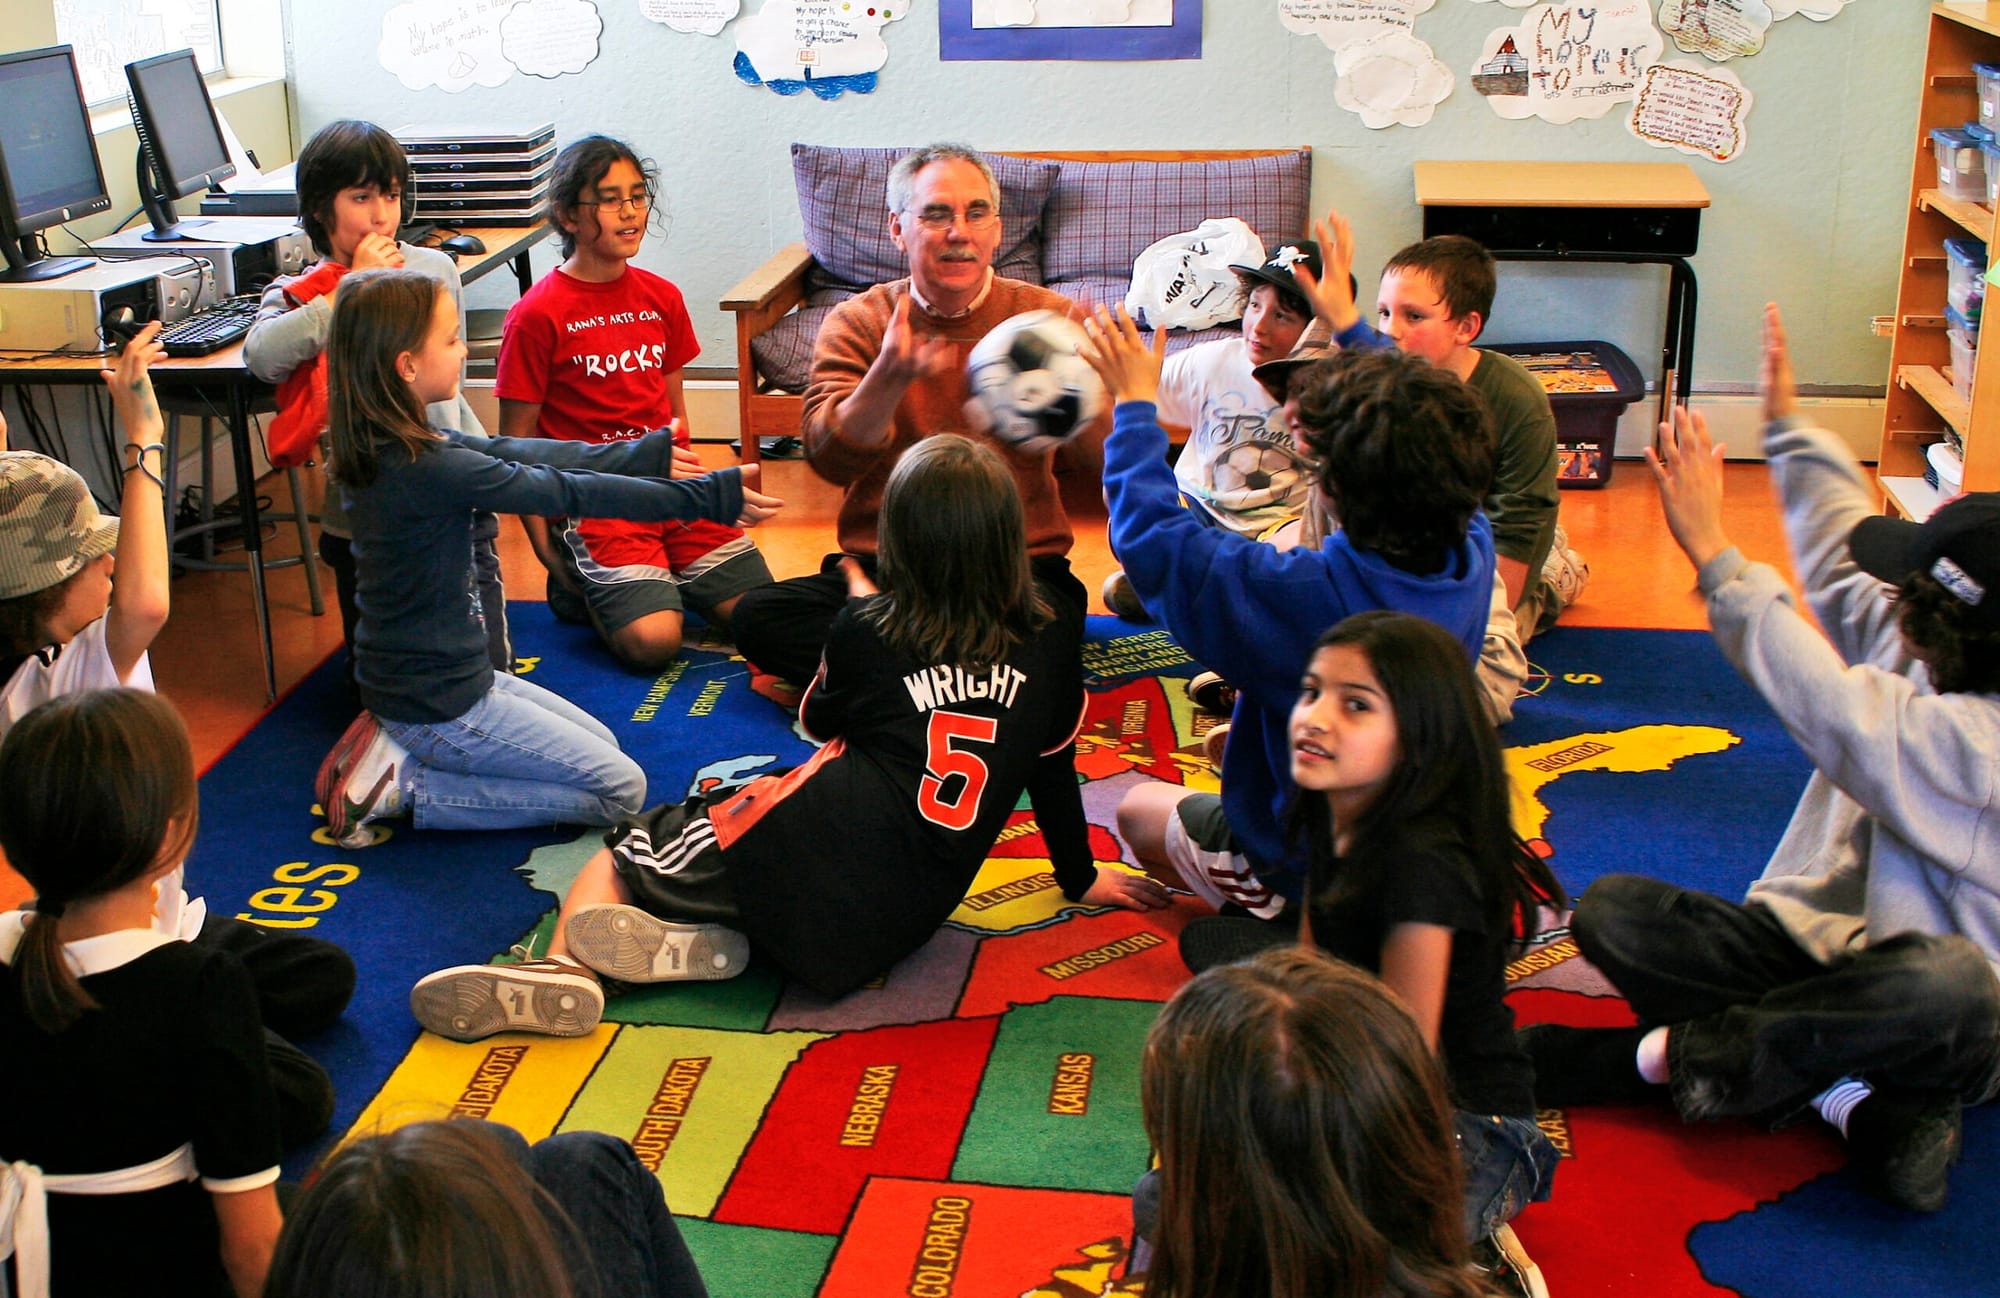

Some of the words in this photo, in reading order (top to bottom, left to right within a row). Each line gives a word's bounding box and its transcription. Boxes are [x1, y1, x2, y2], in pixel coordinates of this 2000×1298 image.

[430, 17, 454, 35] hope
[1536, 7, 1598, 45] My
[1531, 66, 1571, 92] to
[566, 316, 606, 333] RANA'S
[609, 312, 635, 326] ARTS
[1082, 646, 1187, 669] MARYLAND
[687, 680, 728, 717] VERMONT
[903, 663, 1027, 713] WRIGHT
[630, 703, 660, 722] NEW
[1121, 700, 1148, 735] VIRGINIA
[917, 709, 998, 831] 5
[1530, 741, 1612, 771] FLORIDA
[964, 873, 1057, 909] ILLINOIS
[1042, 932, 1163, 980] MISSOURI
[467, 1046, 523, 1102] DAKOTA
[651, 1058, 706, 1115] DAKOTA
[1051, 1054, 1092, 1115] KANSAS
[841, 1065, 899, 1146] NEBRASKA
[635, 1118, 676, 1172] OUTH
[911, 1197, 971, 1298] COLORADO
